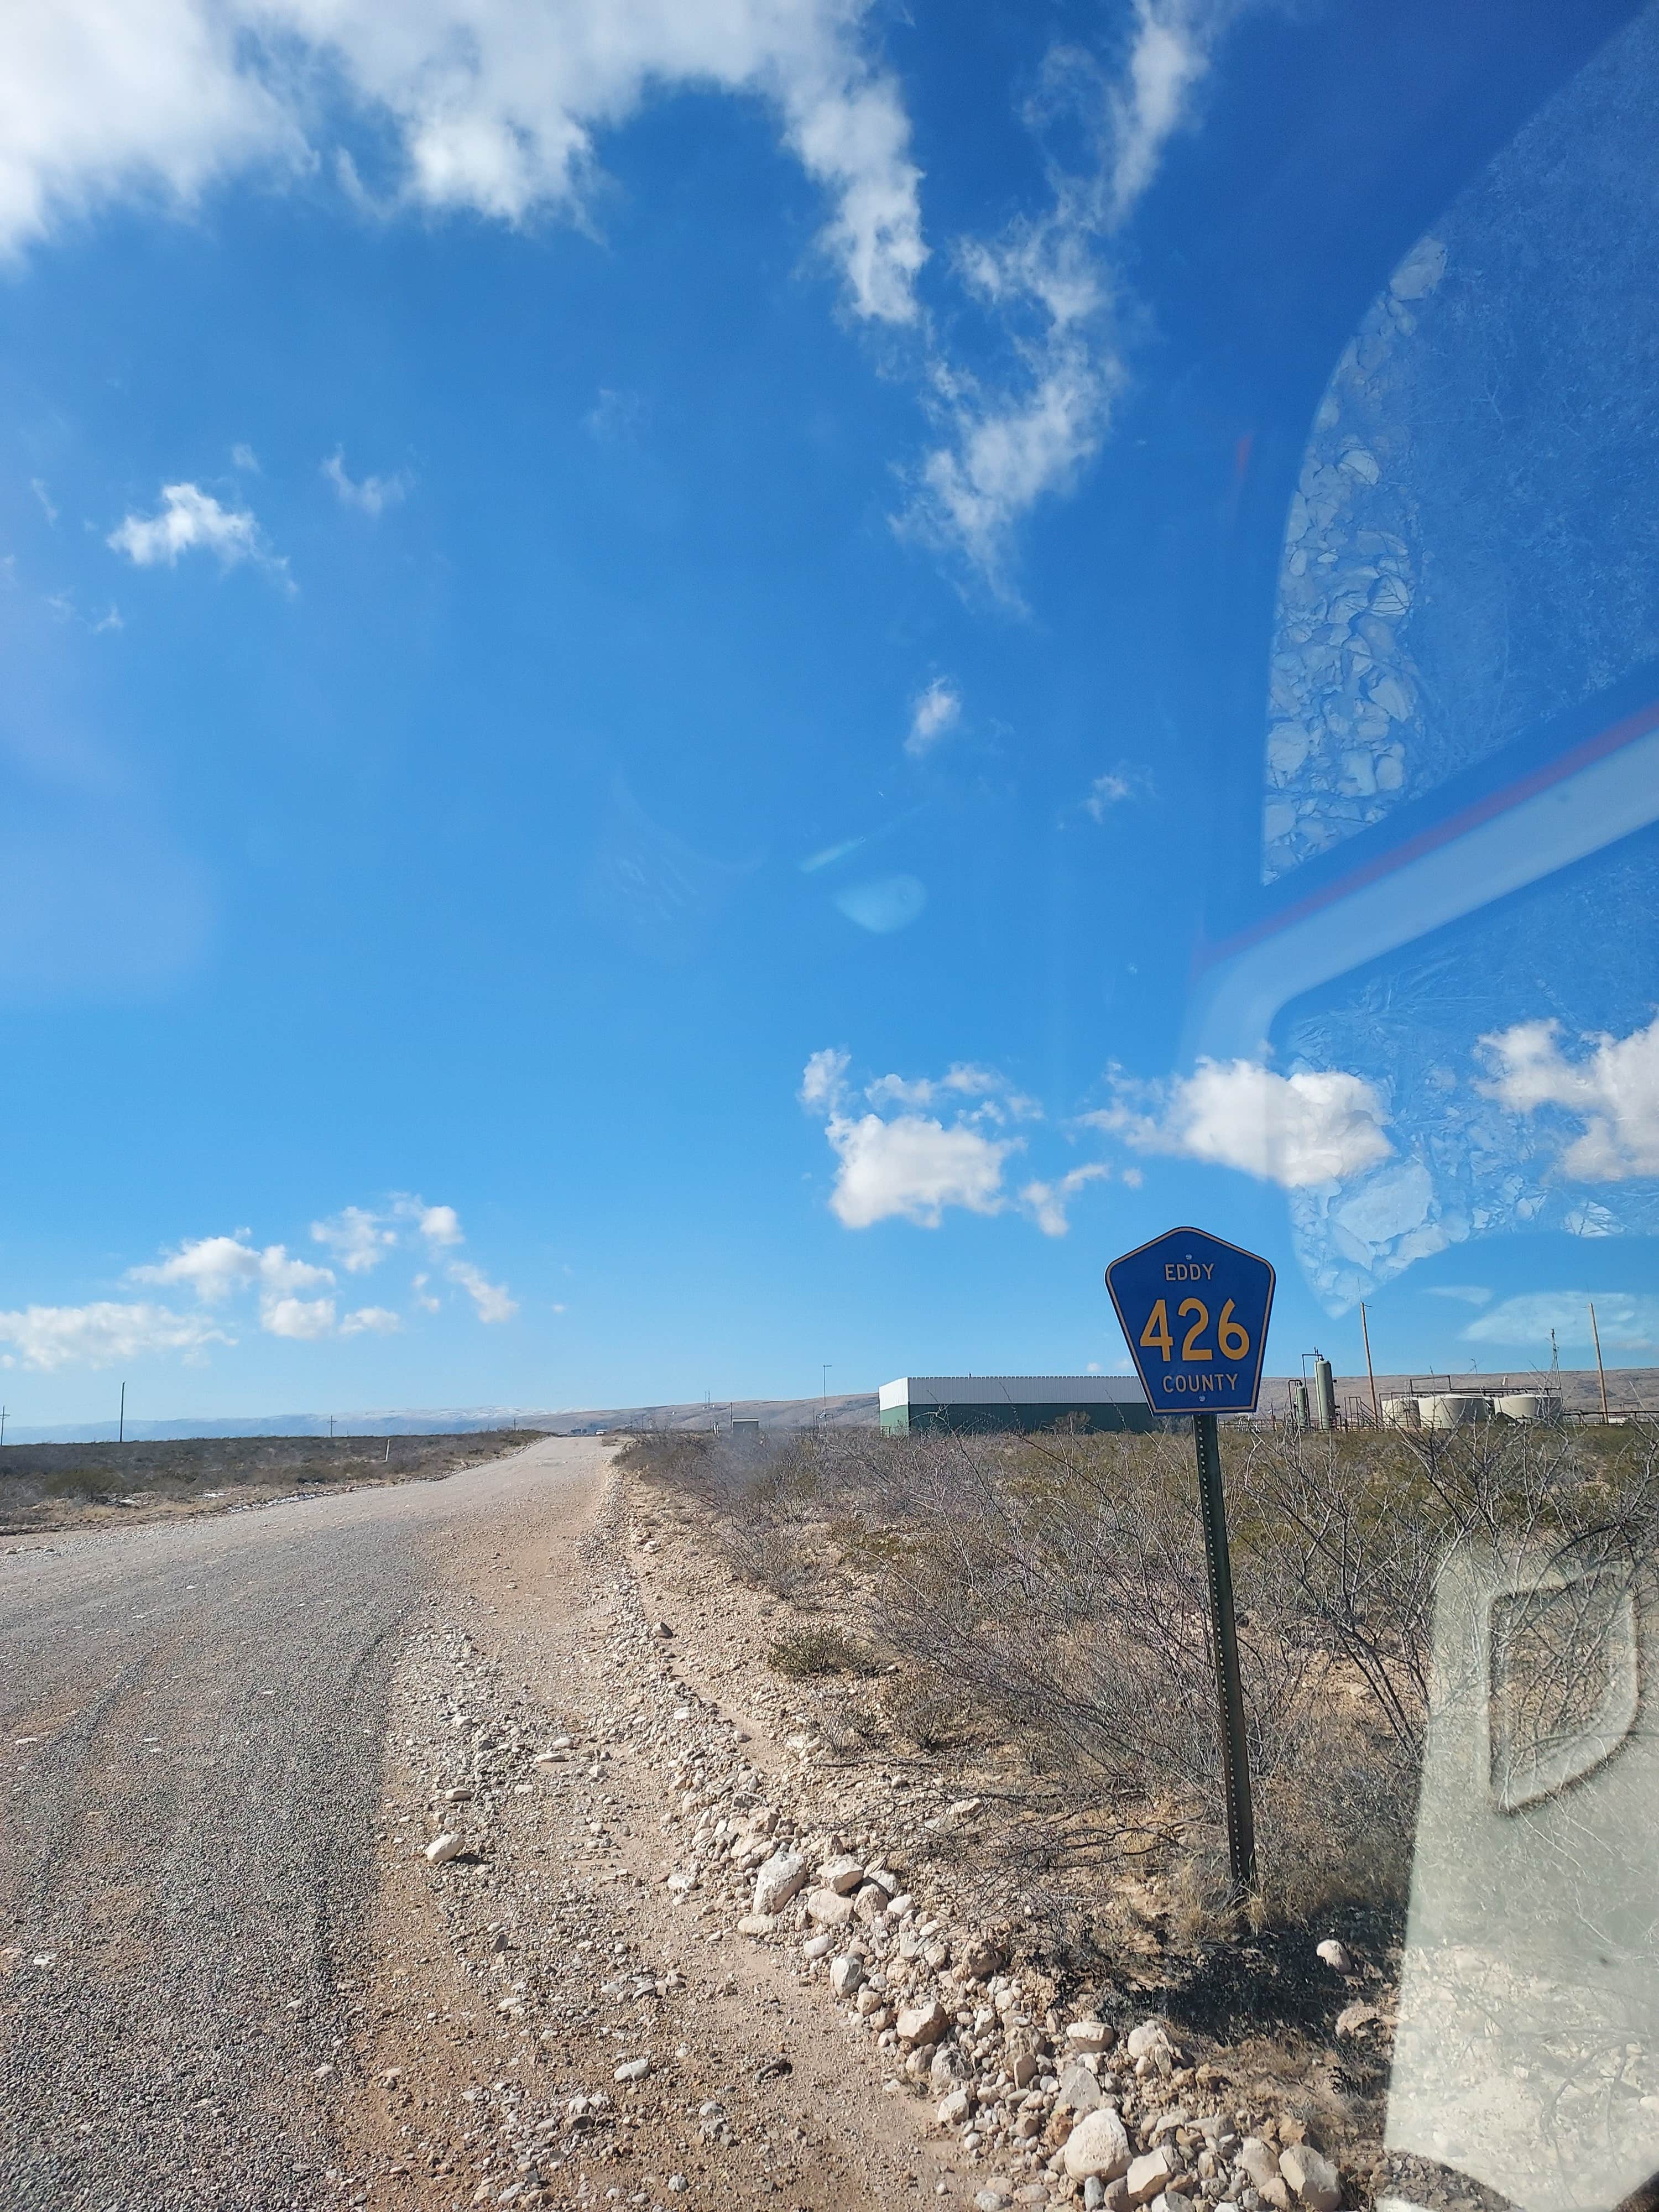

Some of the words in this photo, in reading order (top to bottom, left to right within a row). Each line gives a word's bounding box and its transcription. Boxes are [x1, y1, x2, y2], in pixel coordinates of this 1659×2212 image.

[1165, 1263, 1214, 1281] EDDY
[1140, 1297, 1250, 1361] 426
[1162, 1373, 1238, 1393] COUNTY
